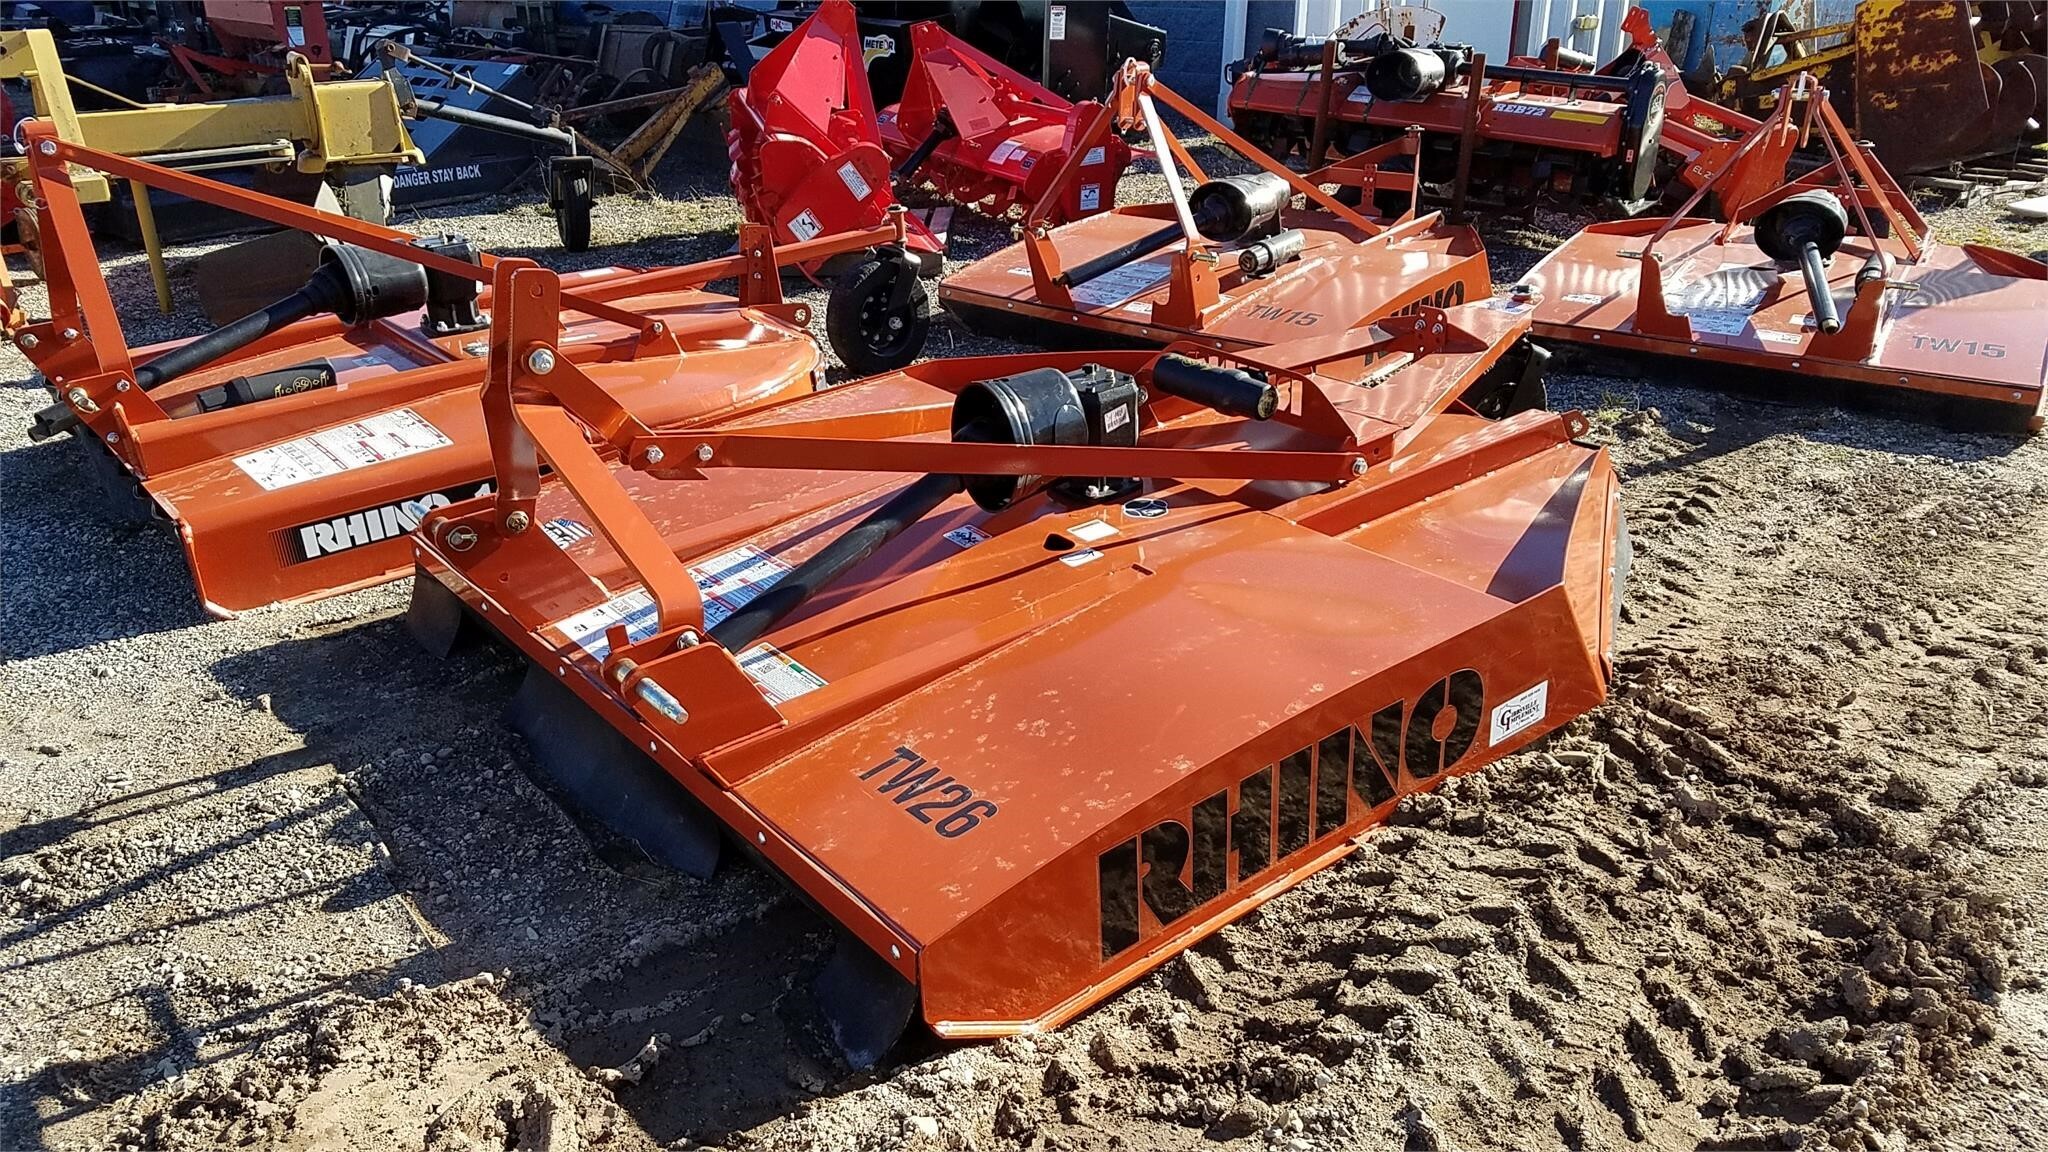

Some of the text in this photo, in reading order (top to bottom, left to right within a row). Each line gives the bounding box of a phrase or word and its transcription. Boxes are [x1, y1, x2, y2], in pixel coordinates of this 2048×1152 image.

[864, 38, 895, 51] METEOR
[1492, 102, 1546, 117] REB72
[393, 164, 482, 189] DANGER STAY BACK
[1248, 304, 1322, 327] TW15
[1912, 335, 2006, 358] TW15
[859, 745, 998, 838] TW26
[1098, 668, 1485, 963] RHINO
